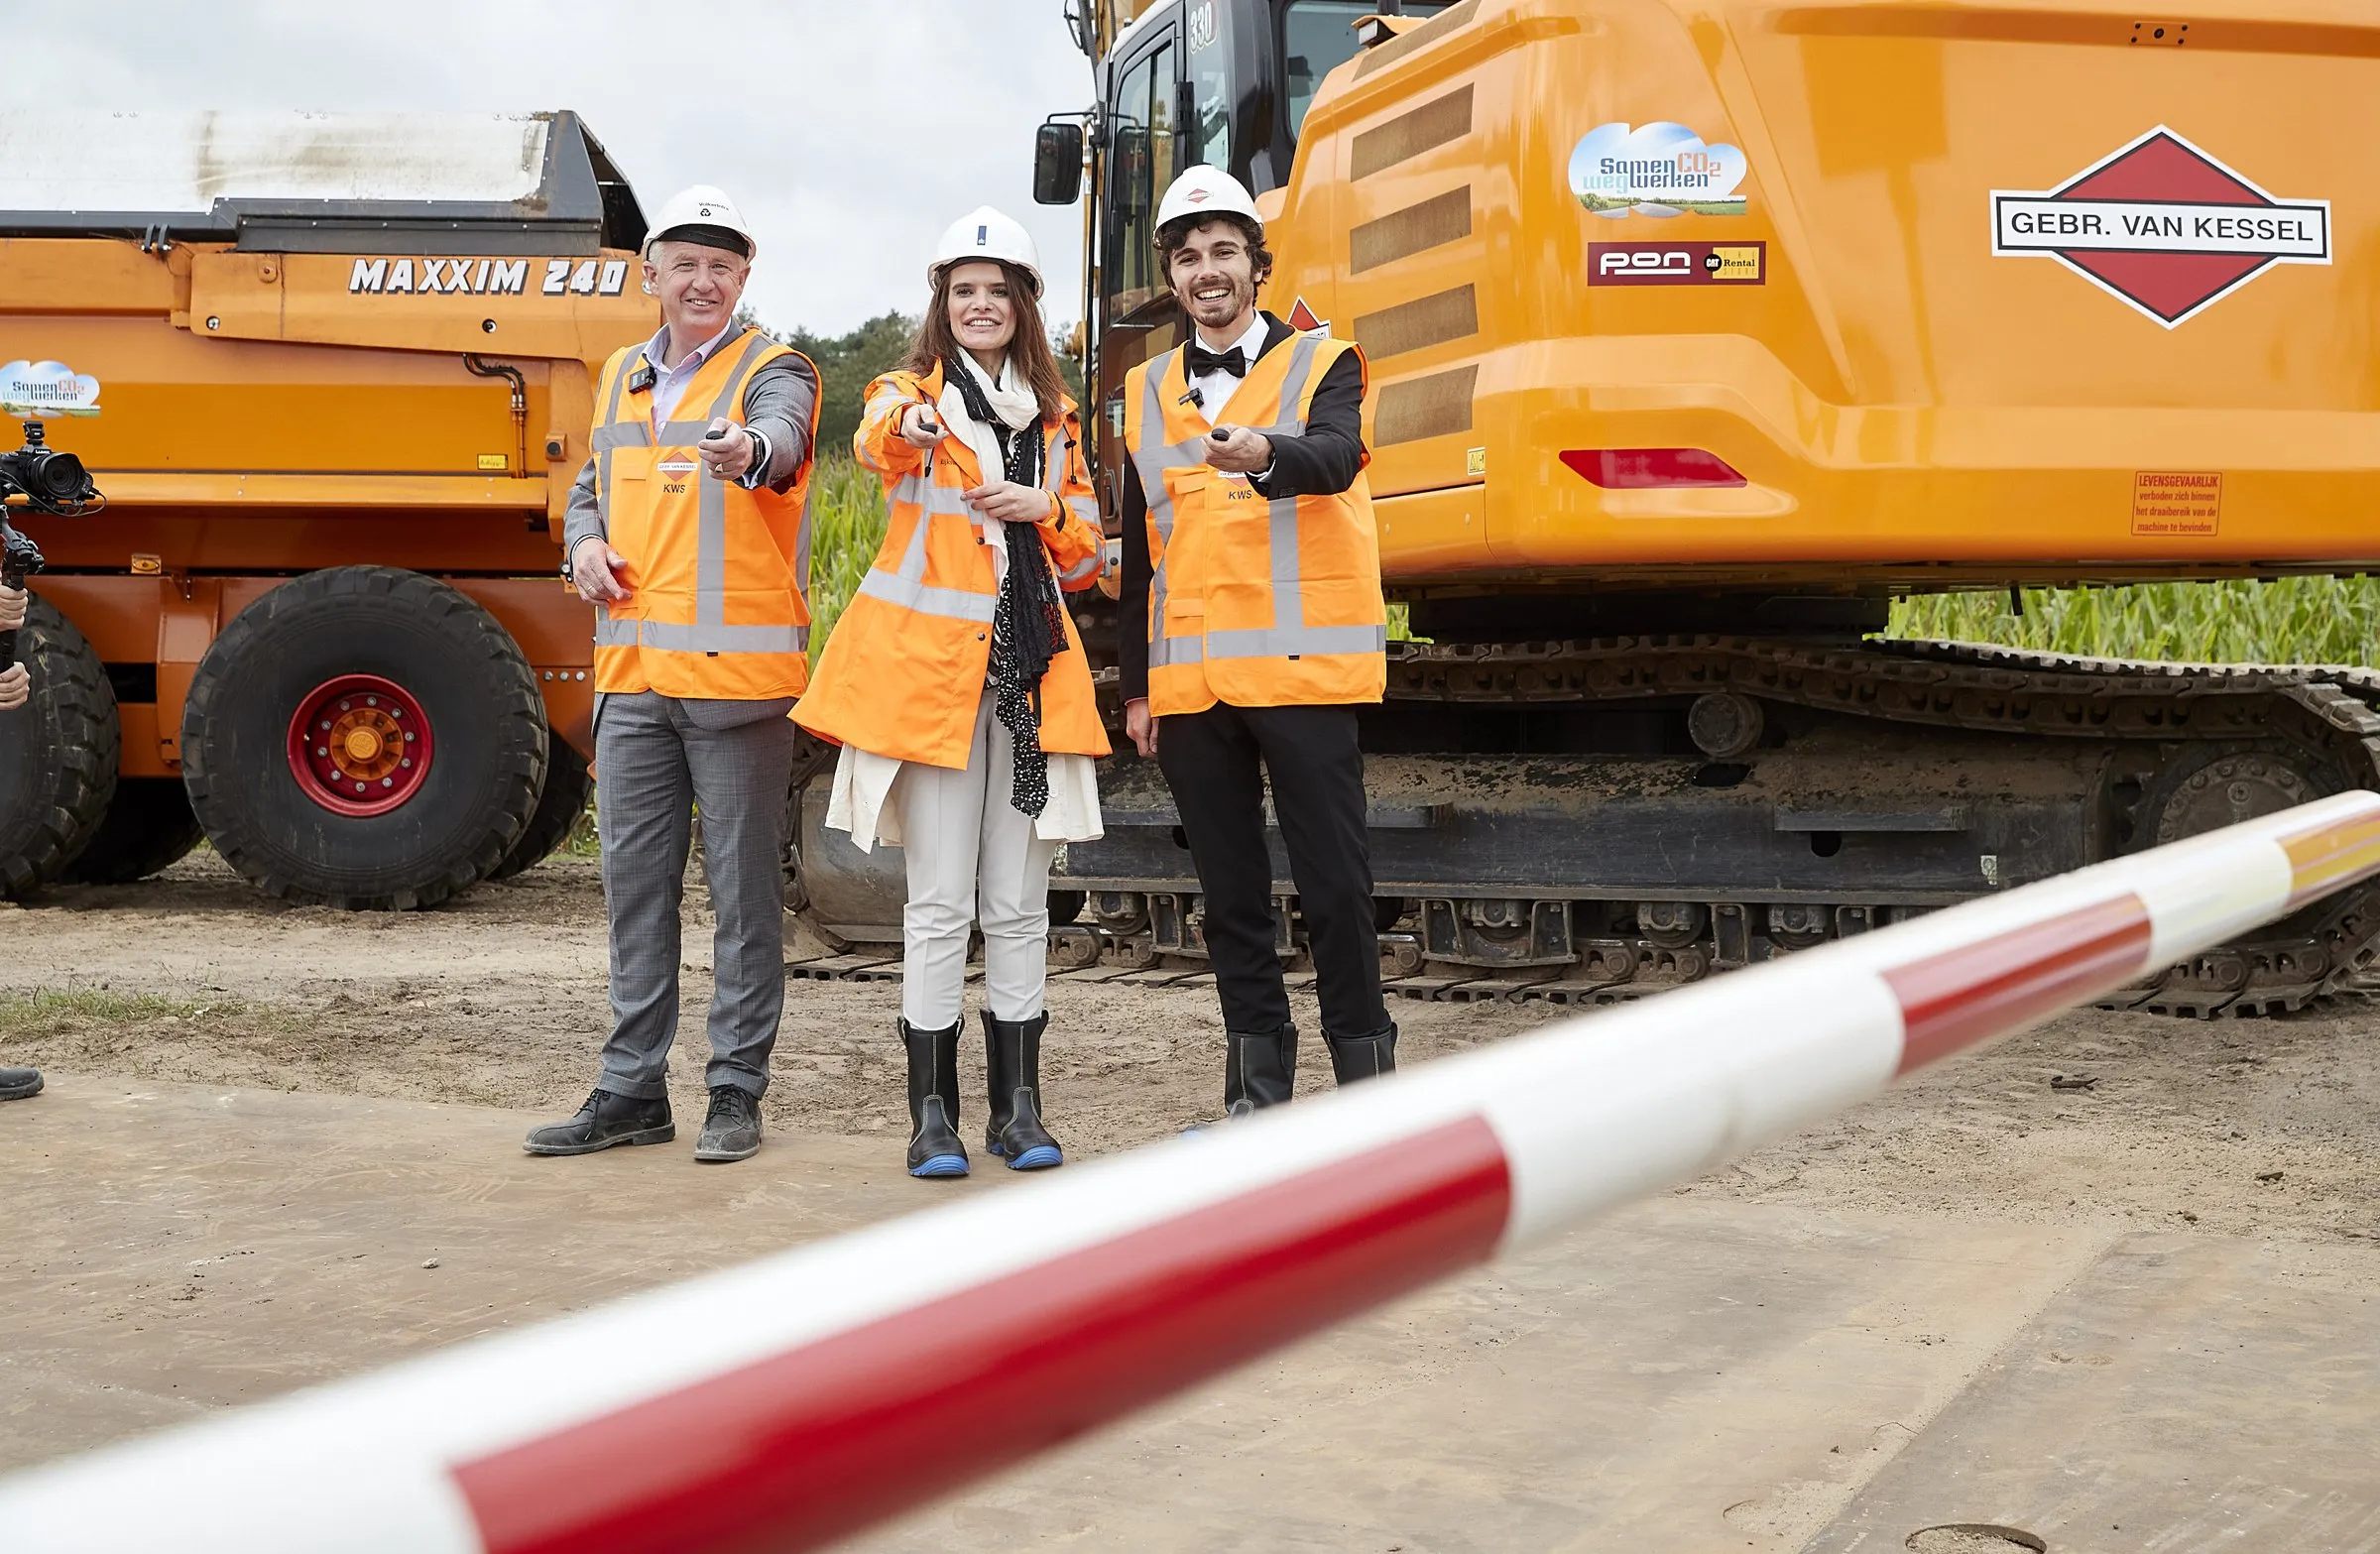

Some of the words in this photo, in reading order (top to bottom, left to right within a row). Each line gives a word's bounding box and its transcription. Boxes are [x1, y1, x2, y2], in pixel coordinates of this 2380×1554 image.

[1190, 1, 1216, 54] 330
[1601, 158, 1676, 177] Samen
[2011, 211, 2112, 236] GEBR.
[2122, 214, 2184, 238] VAN
[2195, 217, 2315, 241] KESSEL
[1706, 258, 1720, 268] CAT
[349, 258, 531, 295] MAXXIM
[541, 259, 630, 297] 240
[2139, 475, 2218, 488] LEVENSGEVAARLIJK
[663, 483, 686, 494] KWS
[1229, 489, 1252, 500] KWS
[2139, 490, 2174, 501] verboden
[2174, 490, 2190, 501] zich
[2191, 491, 2215, 501] binnen
[2136, 506, 2148, 517] het
[2150, 506, 2191, 517] draaibereik
[2193, 508, 2206, 517] van
[2207, 507, 2216, 517] de
[2137, 522, 2169, 533] machine
[2170, 523, 2178, 533] te
[2179, 522, 2212, 533] bevinden
